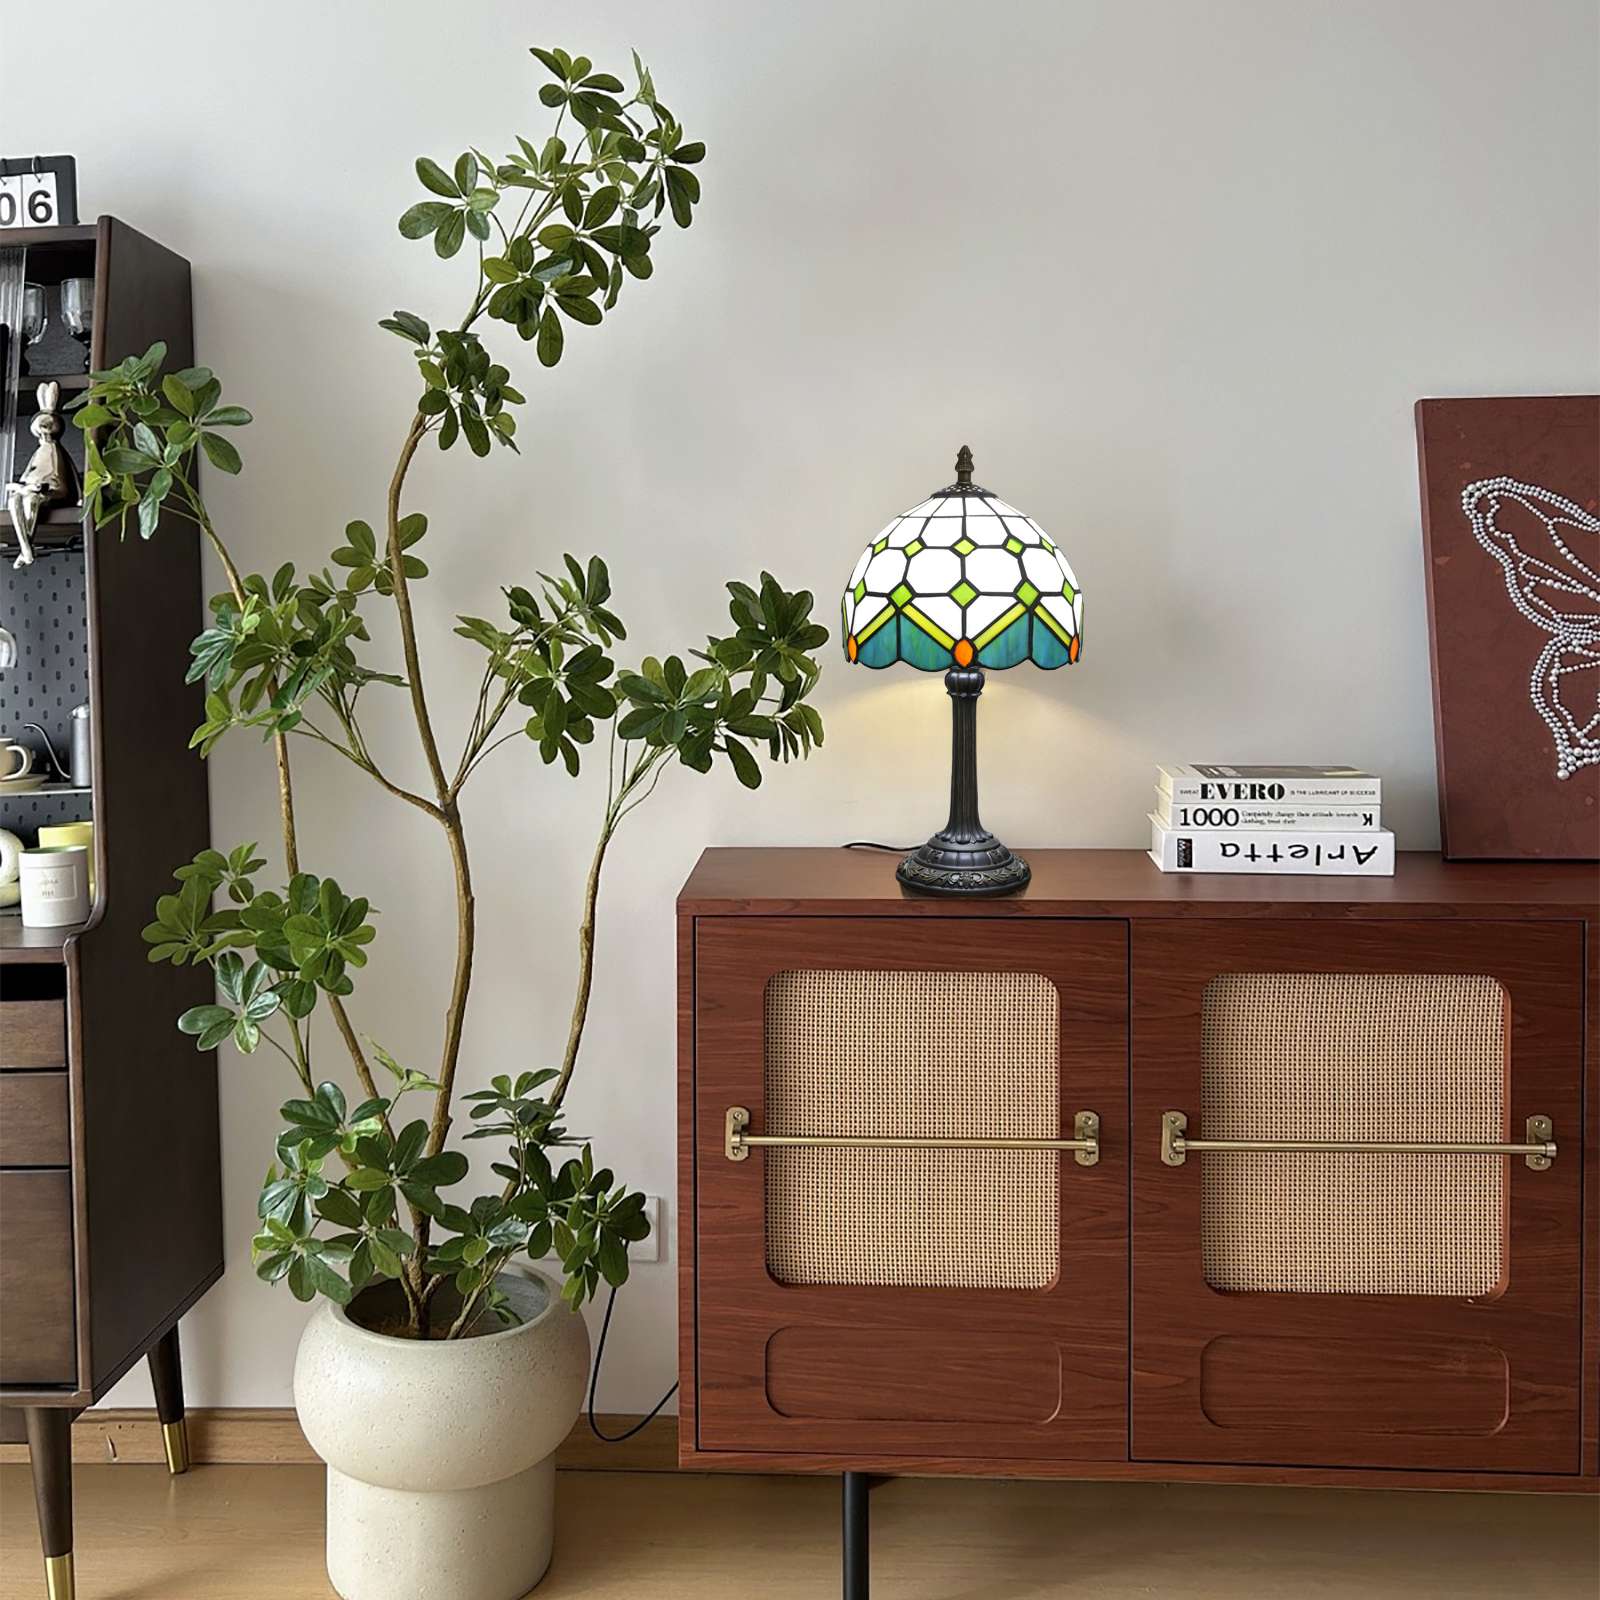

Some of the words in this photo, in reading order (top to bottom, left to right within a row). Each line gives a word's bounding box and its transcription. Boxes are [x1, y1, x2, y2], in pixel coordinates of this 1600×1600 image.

[1200, 783, 1285, 800] EVERO
[1180, 808, 1239, 827] 1000
[1362, 813, 1373, 826] K
[1219, 842, 1379, 866] Arletta
